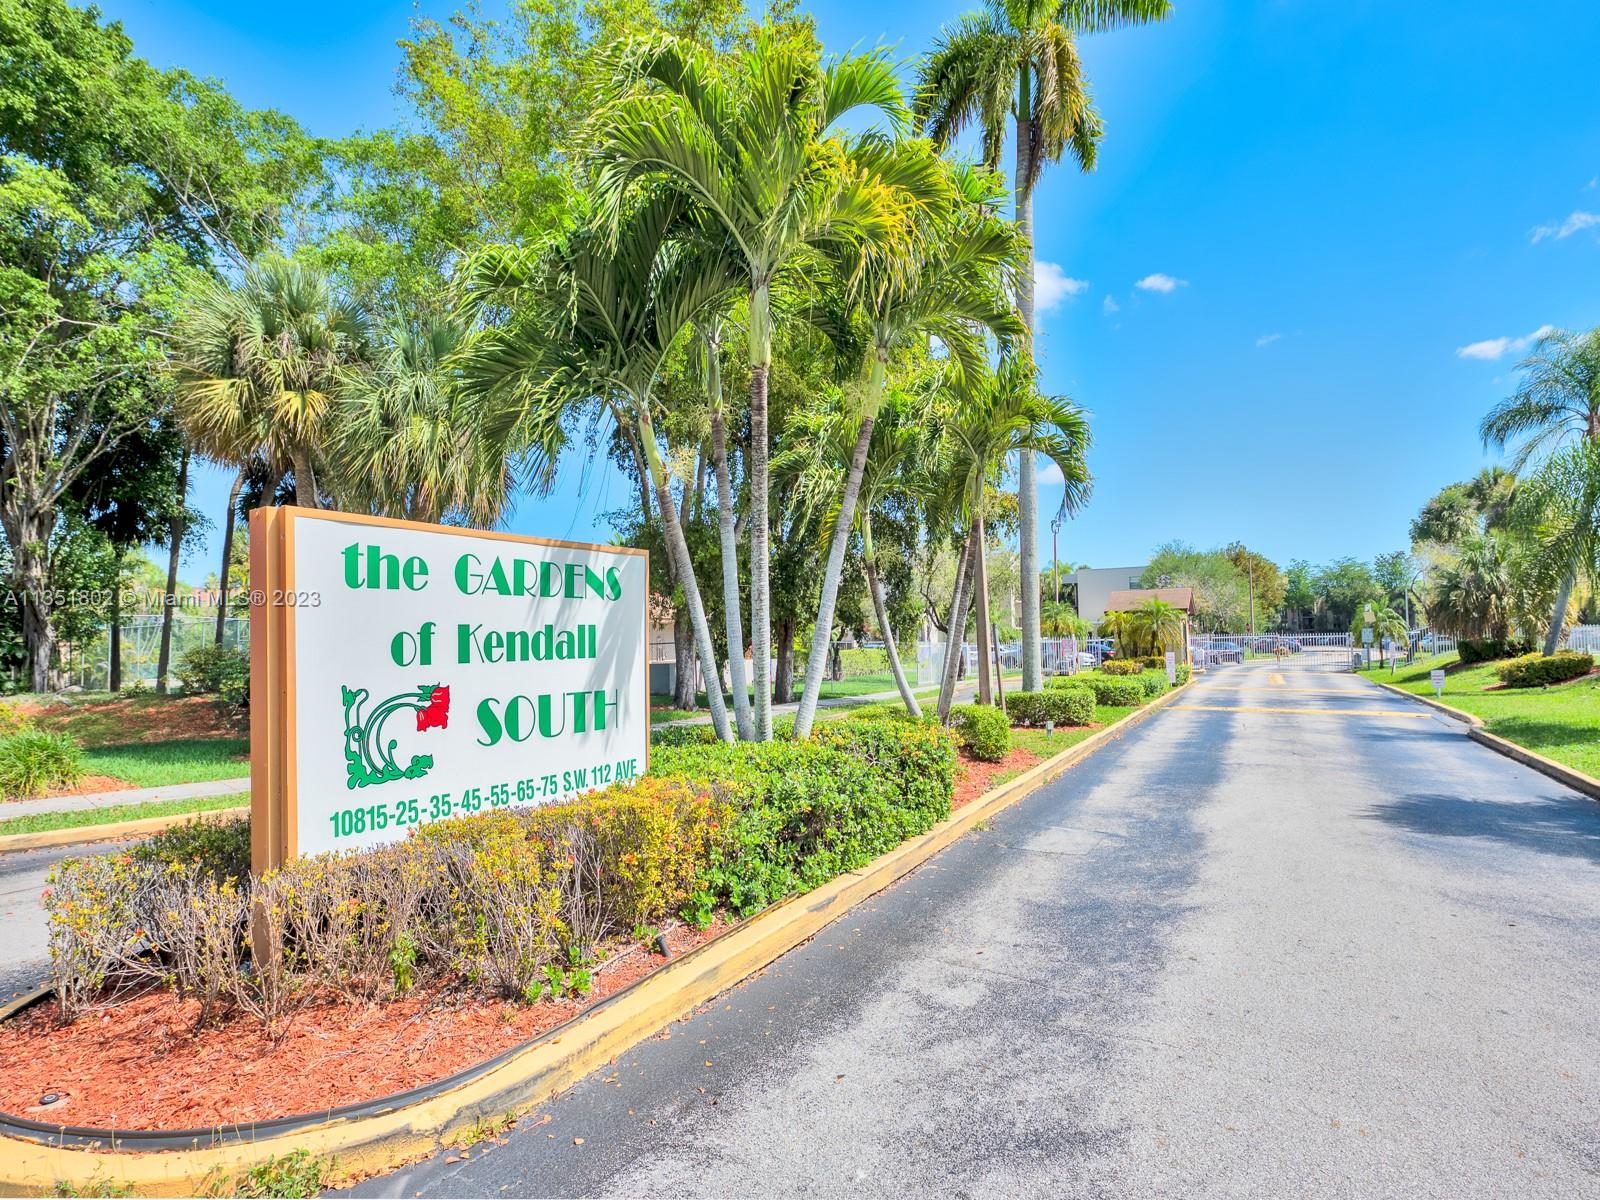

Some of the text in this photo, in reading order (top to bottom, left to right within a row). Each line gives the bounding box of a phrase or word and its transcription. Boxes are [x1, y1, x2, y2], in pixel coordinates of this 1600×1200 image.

[341, 542, 622, 602] the GARDENS
[390, 621, 597, 668] of Kendall
[476, 688, 618, 747] SOUTH
[591, 763, 612, 786] 112
[614, 758, 638, 784] AVE
